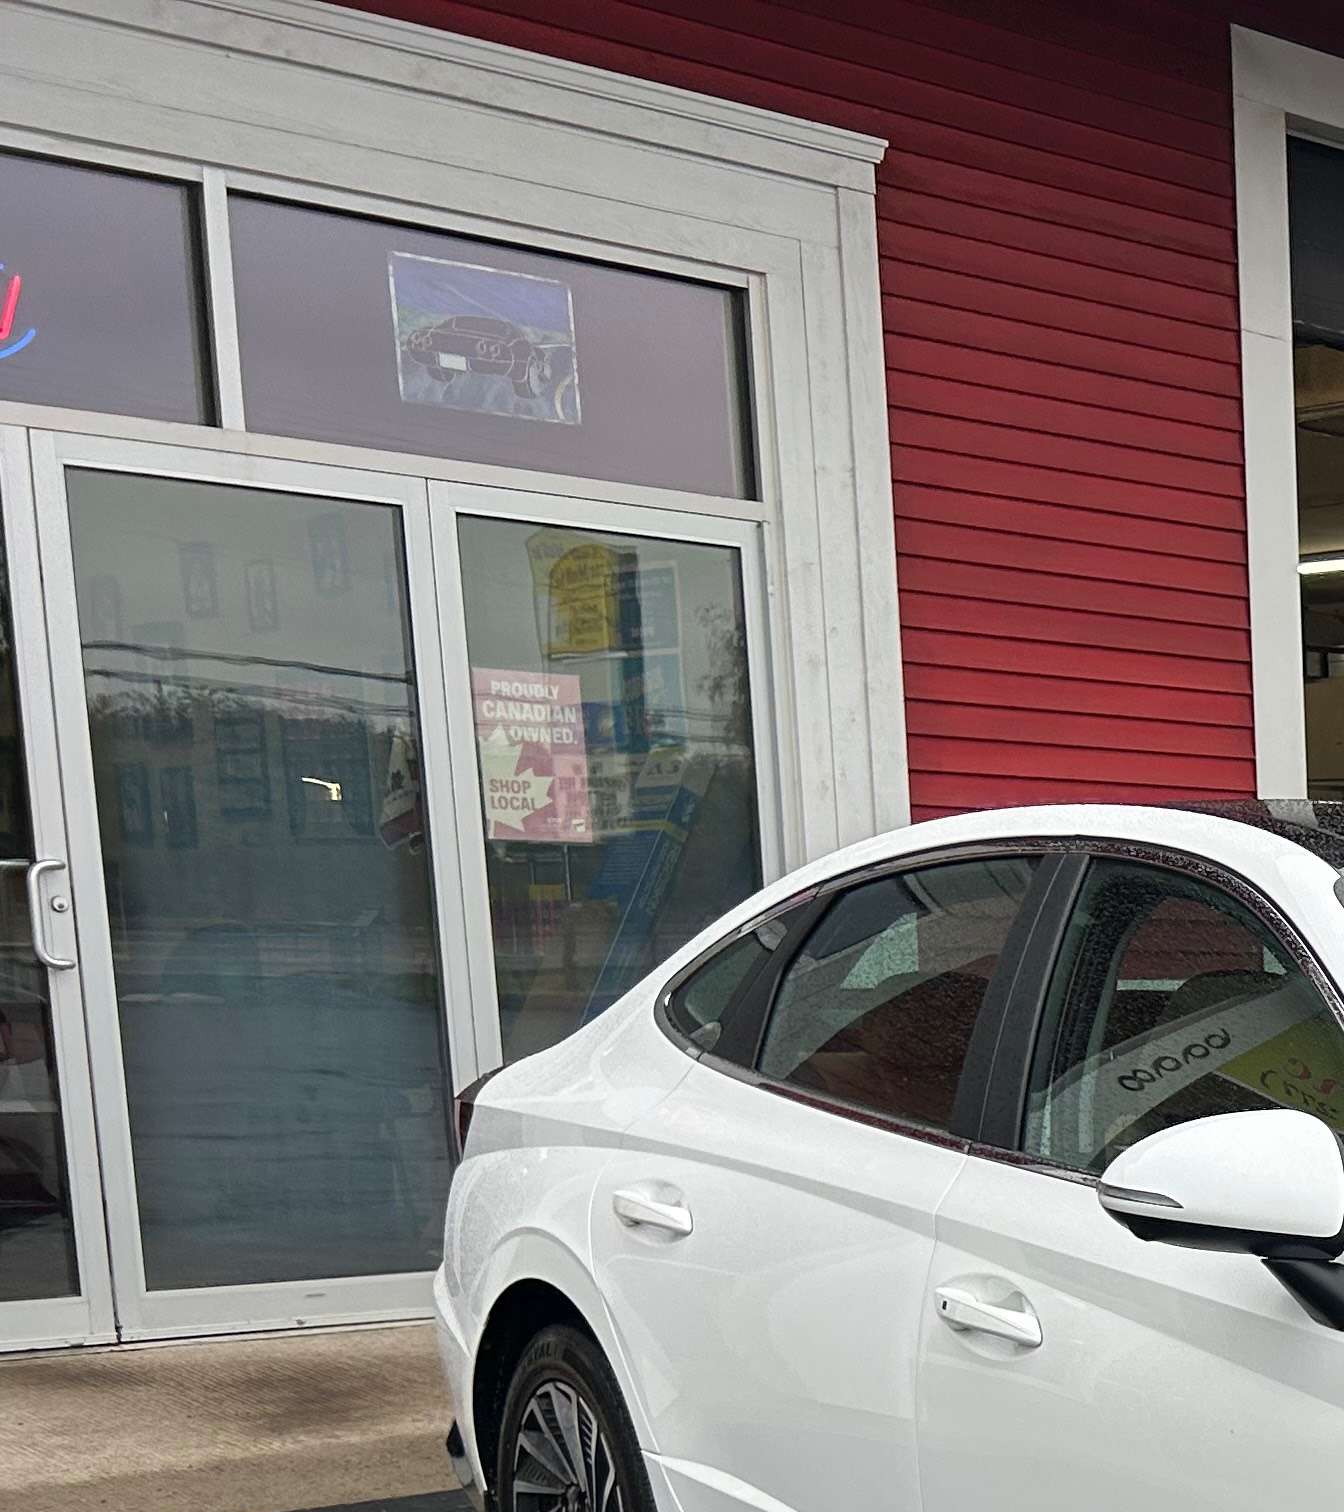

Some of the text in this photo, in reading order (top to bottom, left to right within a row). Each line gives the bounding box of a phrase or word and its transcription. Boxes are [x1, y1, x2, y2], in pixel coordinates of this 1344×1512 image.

[489, 679, 560, 700] PROUDLY
[482, 700, 577, 723] CANADIAN
[510, 725, 578, 745] OWNED.
[489, 778, 531, 795] SHOP
[490, 796, 537, 811] LOCAL
